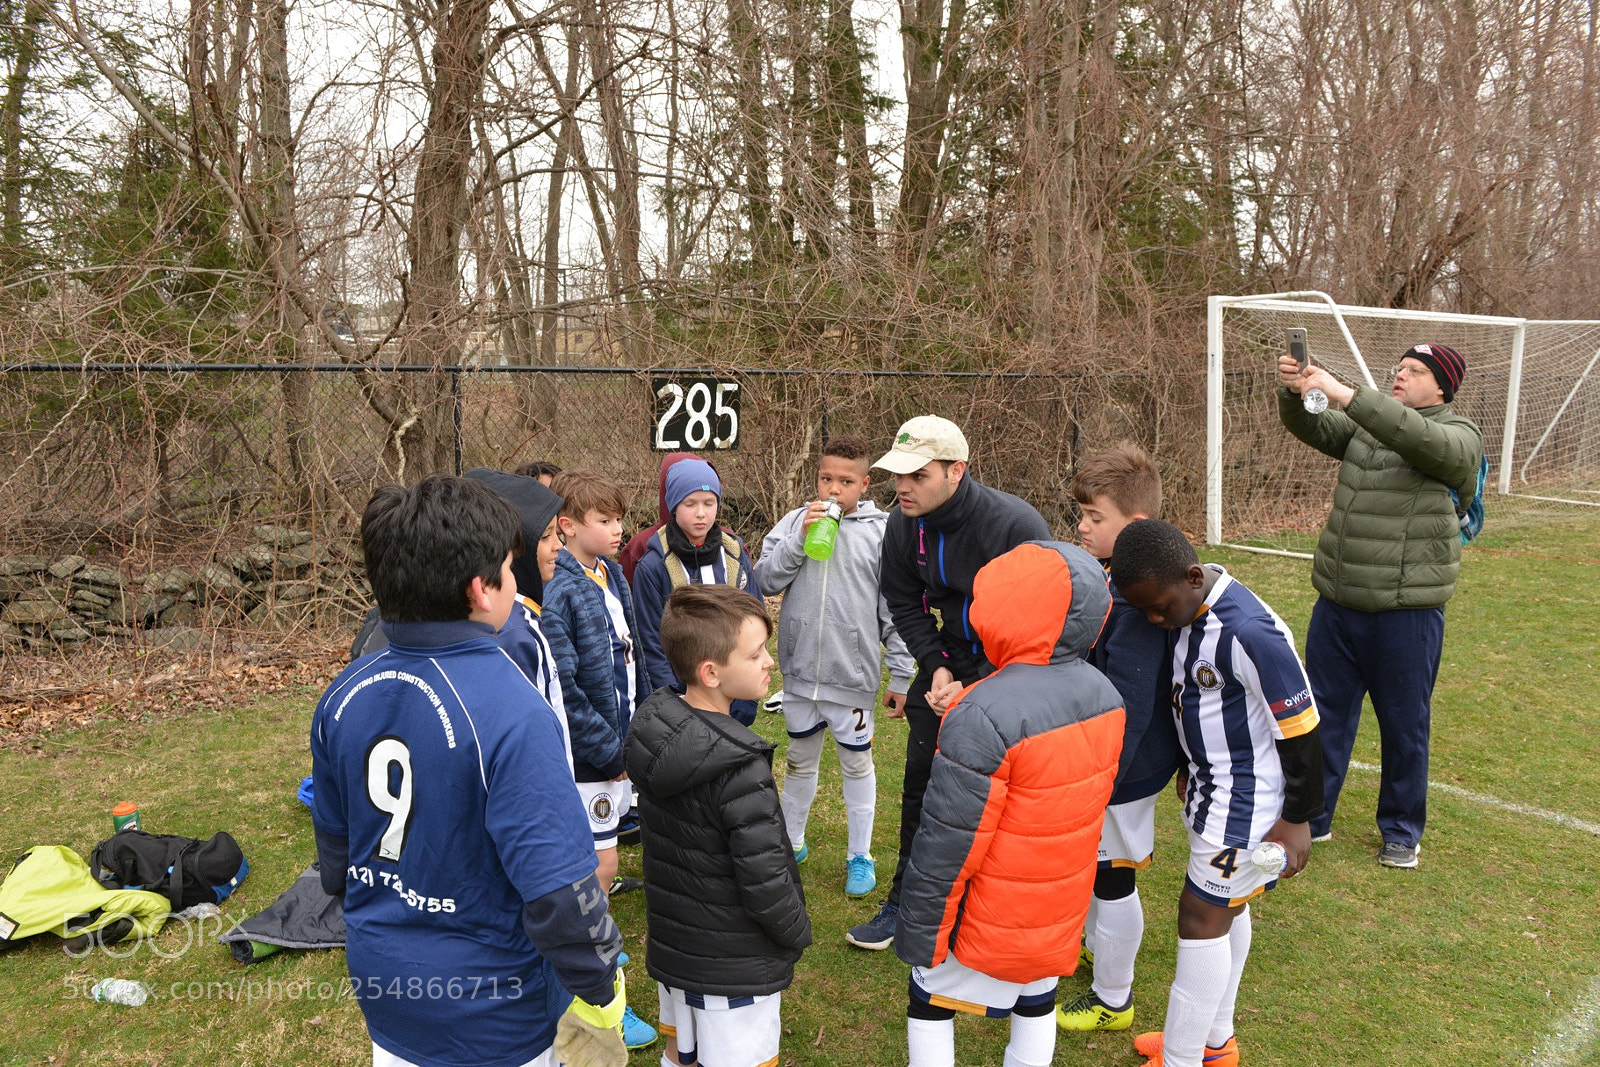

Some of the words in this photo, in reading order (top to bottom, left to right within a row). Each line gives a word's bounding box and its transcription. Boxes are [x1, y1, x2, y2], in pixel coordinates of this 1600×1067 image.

[656, 382, 739, 449] 285
[373, 670, 397, 682] INJURED
[397, 670, 442, 707] CONSTRUCTION
[436, 704, 456, 749] WORKERS
[852, 707, 867, 732] 2
[364, 734, 413, 864] 9
[1209, 847, 1240, 879] 4
